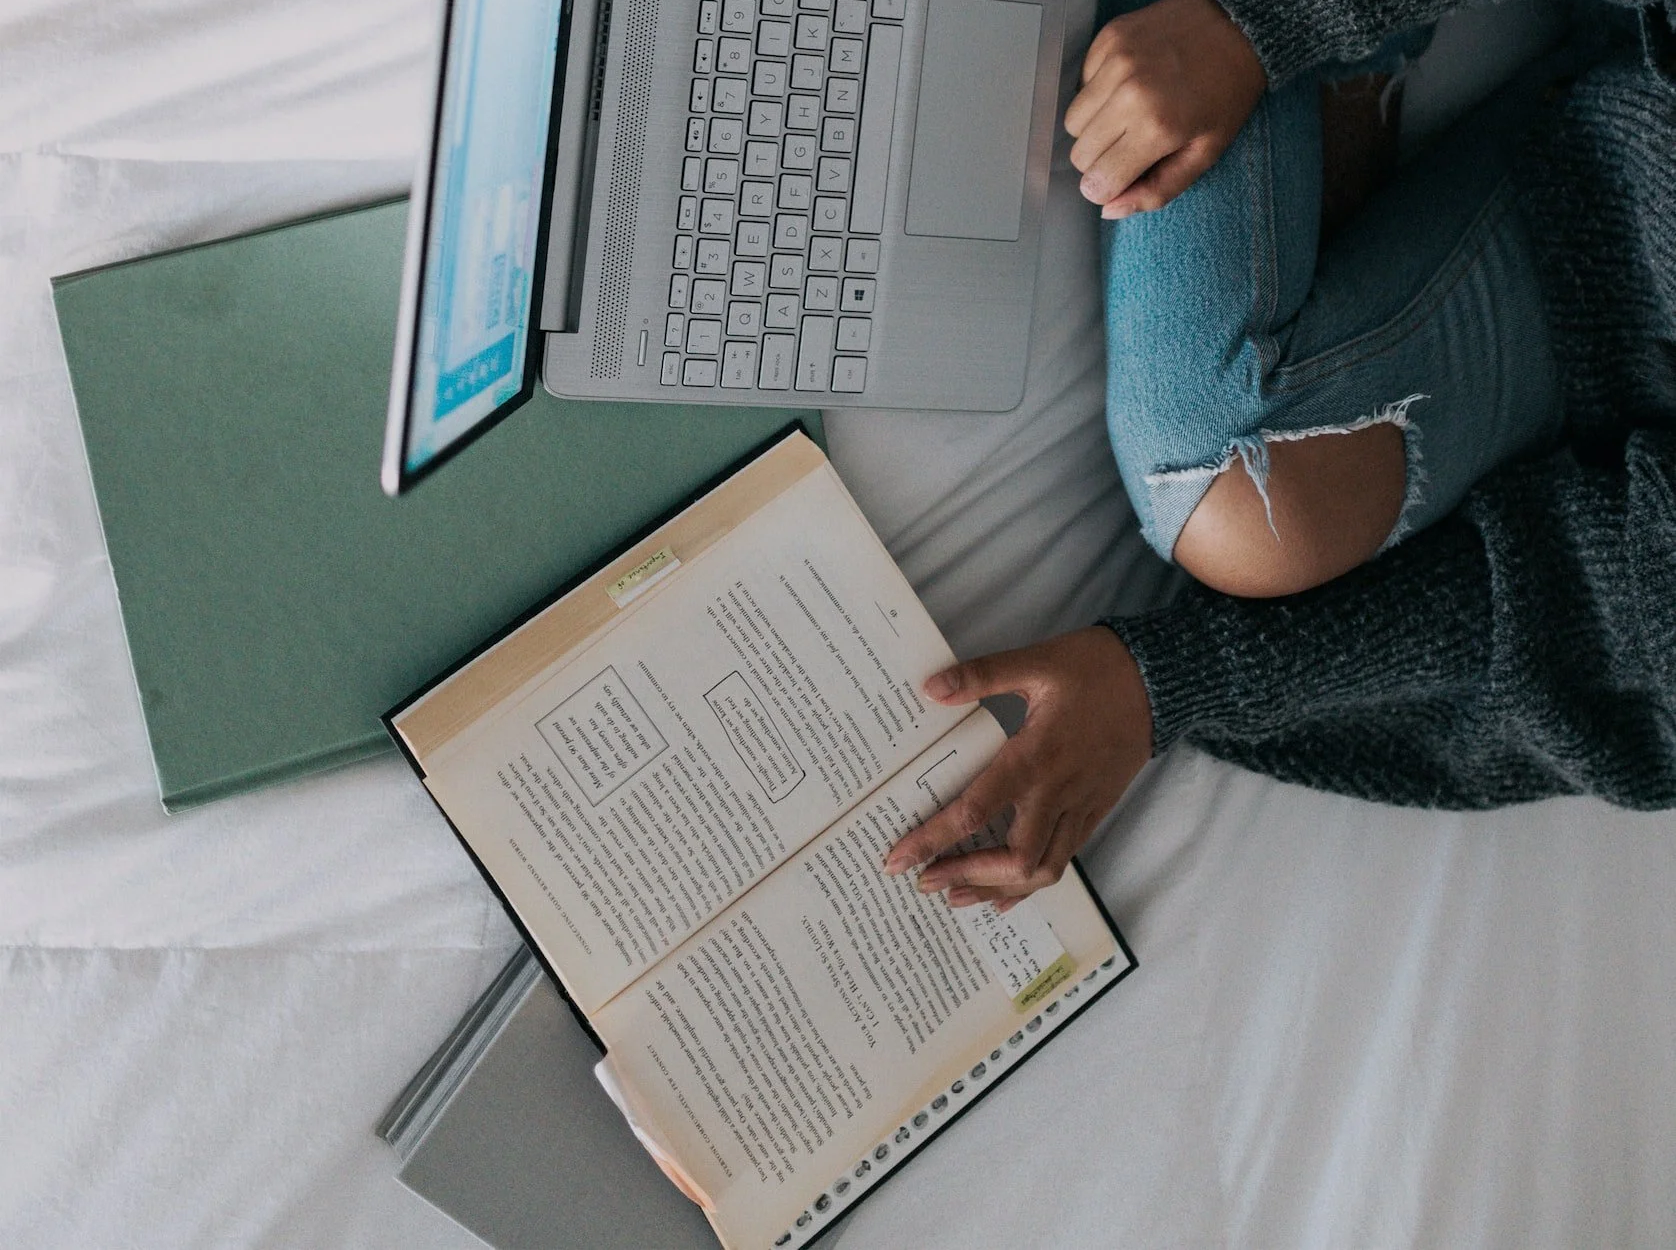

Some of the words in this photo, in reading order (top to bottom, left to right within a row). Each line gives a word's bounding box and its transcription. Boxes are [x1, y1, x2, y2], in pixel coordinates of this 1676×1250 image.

[733, 11, 744, 19] 9
[807, 27, 818, 38] K
[729, 51, 740, 59] 8
[841, 49, 853, 61] M
[803, 67, 814, 75] J
[764, 73, 775, 84] U
[837, 89, 848, 100] N
[798, 106, 809, 117] H
[760, 113, 771, 124] Y
[720, 131, 732, 140] 6
[833, 130, 844, 140] B
[794, 146, 805, 157] G
[756, 154, 767, 163] T
[716, 172, 727, 180] 5
[829, 168, 840, 180] V
[790, 188, 801, 196] F
[752, 193, 763, 204] R
[712, 211, 722, 220] 4
[824, 208, 836, 220] C
[786, 225, 797, 237] D
[748, 234, 759, 243] E
[708, 252, 719, 260] 3
[820, 248, 831, 259] X
[781, 266, 793, 276] S
[743, 271, 755, 286] W
[704, 292, 715, 301] 2
[816, 288, 828, 298] Z
[777, 304, 789, 316] A
[738, 312, 751, 325] Q
[600, 682, 614, 697] say.
[711, 698, 726, 717] know
[724, 695, 737, 710] feel
[741, 696, 752, 708] do
[593, 700, 609, 718] with
[609, 695, 633, 725] actually
[734, 708, 744, 719] we
[749, 707, 759, 717] we
[567, 715, 577, 726] we
[586, 717, 599, 731] has
[604, 715, 615, 727] do
[724, 717, 733, 727] we
[551, 719, 574, 746] percent
[612, 725, 621, 734] to
[628, 721, 639, 733] we
[740, 718, 769, 754] something
[755, 716, 783, 752] something
[573, 724, 603, 762] impression
[596, 728, 616, 753] convey
[617, 731, 640, 760] nothing
[635, 732, 651, 750] what
[730, 726, 758, 762] something
[567, 743, 579, 755] 90
[575, 753, 590, 772] than
[597, 759, 609, 772] the
[611, 751, 628, 770] often
[778, 750, 798, 775] Action:
[604, 769, 616, 780] of
[764, 753, 788, 784] Emotion:
[586, 770, 603, 789] More
[753, 760, 779, 792] Thought:
[646, 1042, 670, 1076] CONNECT
[666, 1076, 678, 1091] FEW
[709, 1143, 733, 1177] EVERYONE
